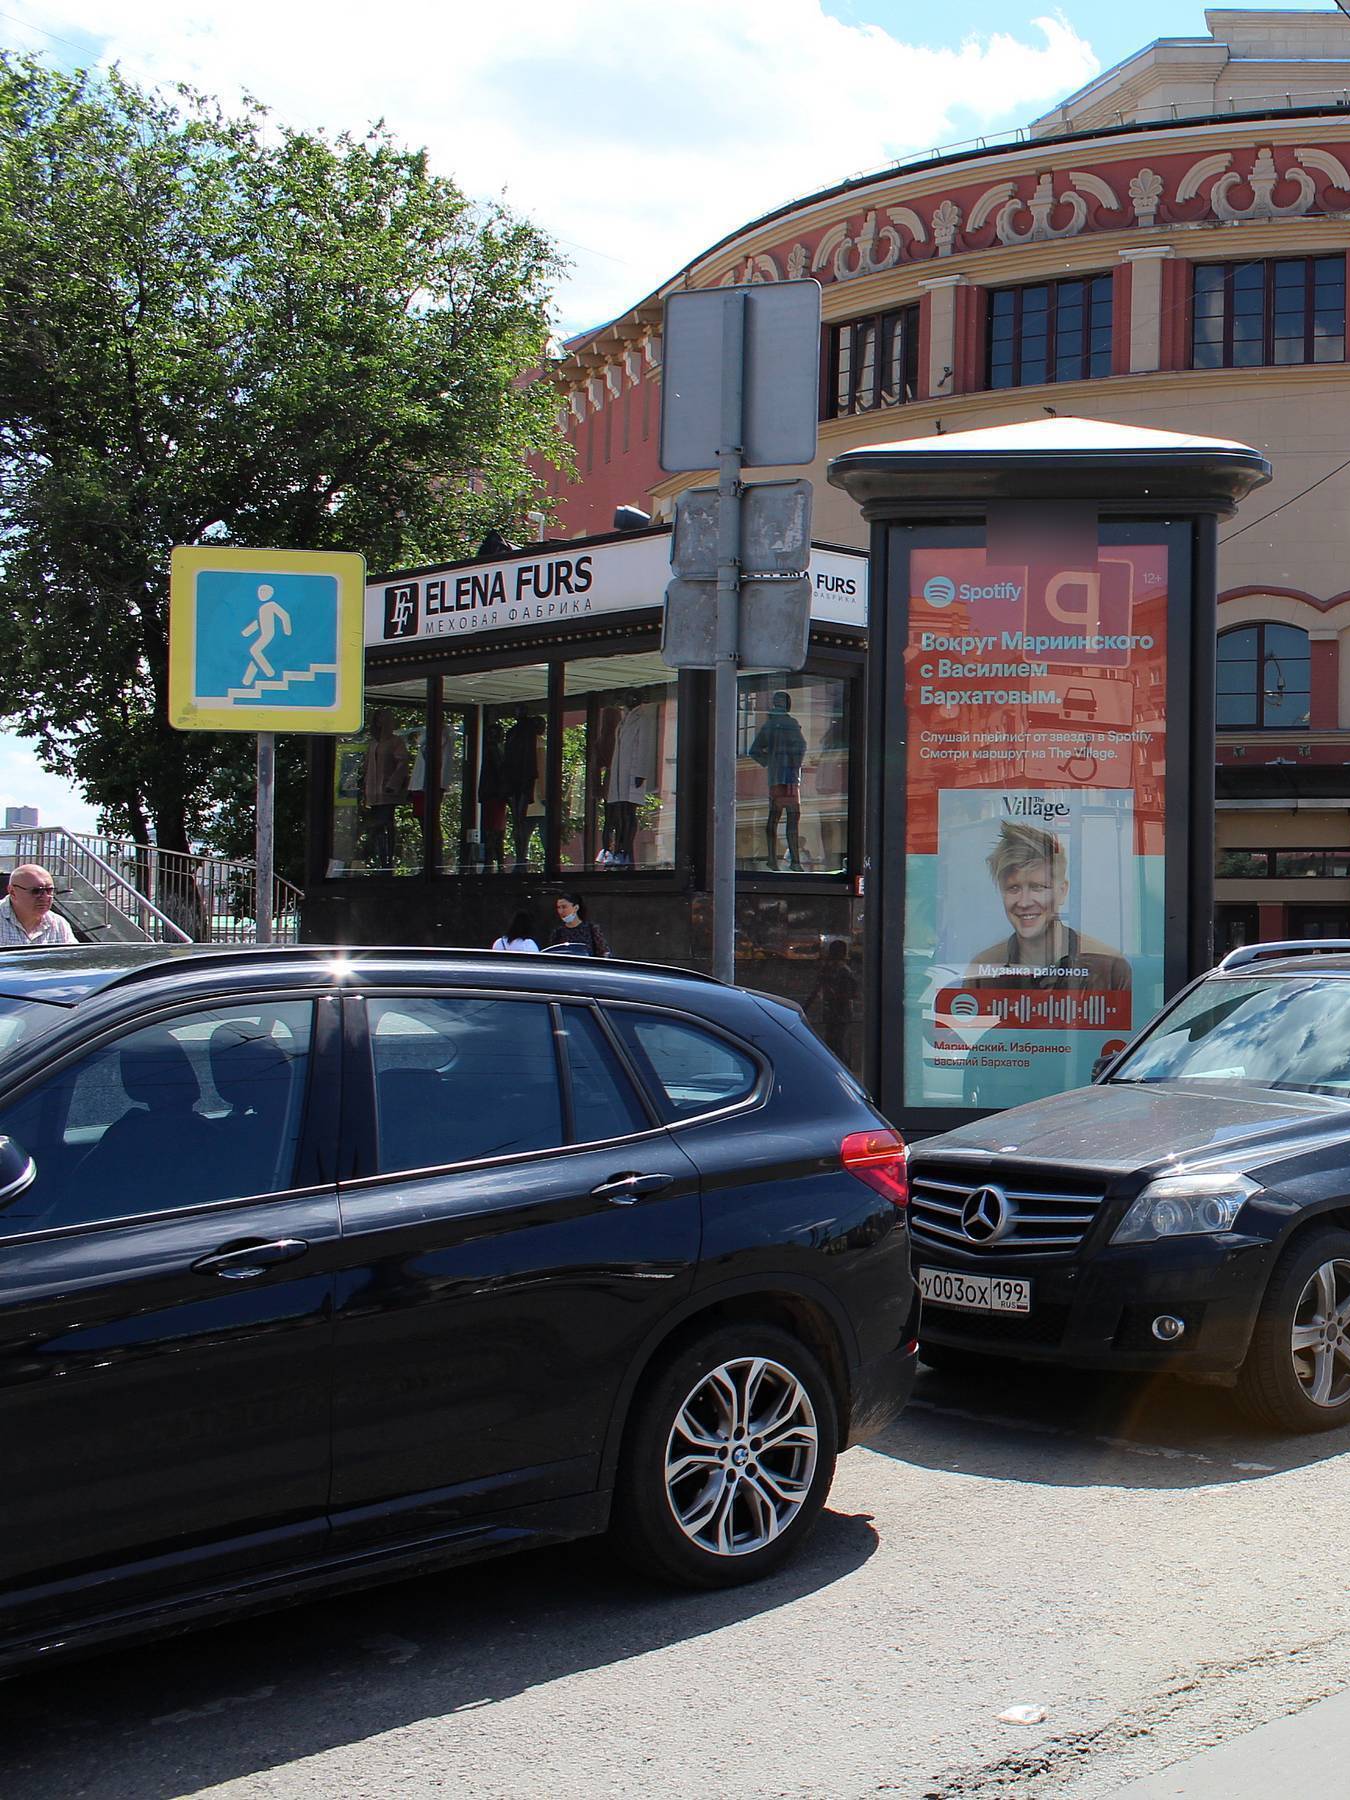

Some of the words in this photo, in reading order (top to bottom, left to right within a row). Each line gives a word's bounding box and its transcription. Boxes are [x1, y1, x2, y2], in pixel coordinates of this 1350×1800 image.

[425, 570, 507, 616] ELENA
[515, 556, 593, 601] FURS
[816, 573, 856, 595] FURS
[1142, 572, 1162, 584] 12+
[959, 582, 1022, 602] Spotify
[425, 611, 498, 634] МЕХОВАЯ
[508, 598, 592, 621] ФАБРИКА
[921, 632, 997, 655] Вокруг
[1001, 631, 1154, 654] Мариинского
[920, 663, 933, 678] с
[938, 659, 1048, 678] Василием
[920, 686, 1063, 709] Бархатовым.
[920, 730, 970, 744] Слушай
[973, 731, 1030, 743] плейлист
[1033, 733, 1047, 742] от
[1049, 733, 1094, 744] звезды
[1098, 733, 1104, 742] в
[1107, 730, 1153, 745] Spotify.
[920, 747, 970, 761] Смотри
[972, 749, 1028, 761] маршрут
[1031, 750, 1046, 759] на
[1049, 747, 1071, 759] The
[1074, 747, 1118, 761] Village.
[1003, 796, 1070, 821] Village
[978, 964, 1031, 978] Музыка
[1033, 965, 1089, 979] районов
[1009, 1041, 1072, 1055] Избранное
[934, 1057, 979, 1067] Василий
[981, 1057, 1030, 1068] Бархатов
[992, 1280, 1024, 1302] 199
[1000, 1301, 1017, 1309] RUS
